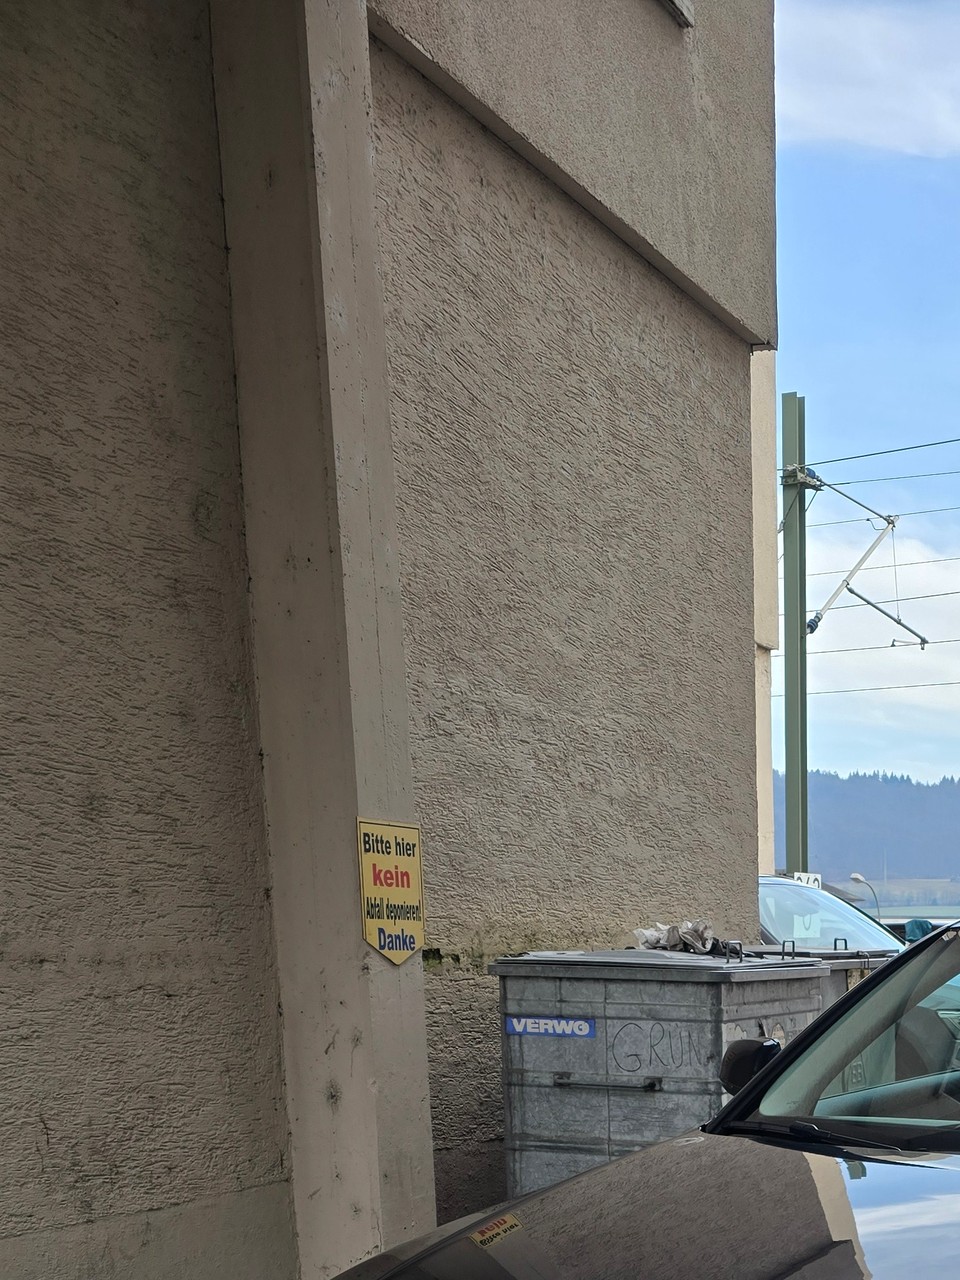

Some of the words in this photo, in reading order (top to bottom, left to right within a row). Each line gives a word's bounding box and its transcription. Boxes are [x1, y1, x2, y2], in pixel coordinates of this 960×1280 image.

[363, 832, 391, 855] Bitte
[394, 835, 416, 857] hier
[372, 863, 410, 888] kein
[366, 897, 385, 920] Abfall
[386, 898, 421, 925] deponieren!
[377, 927, 416, 951] Danke
[512, 1018, 590, 1036] VERWO
